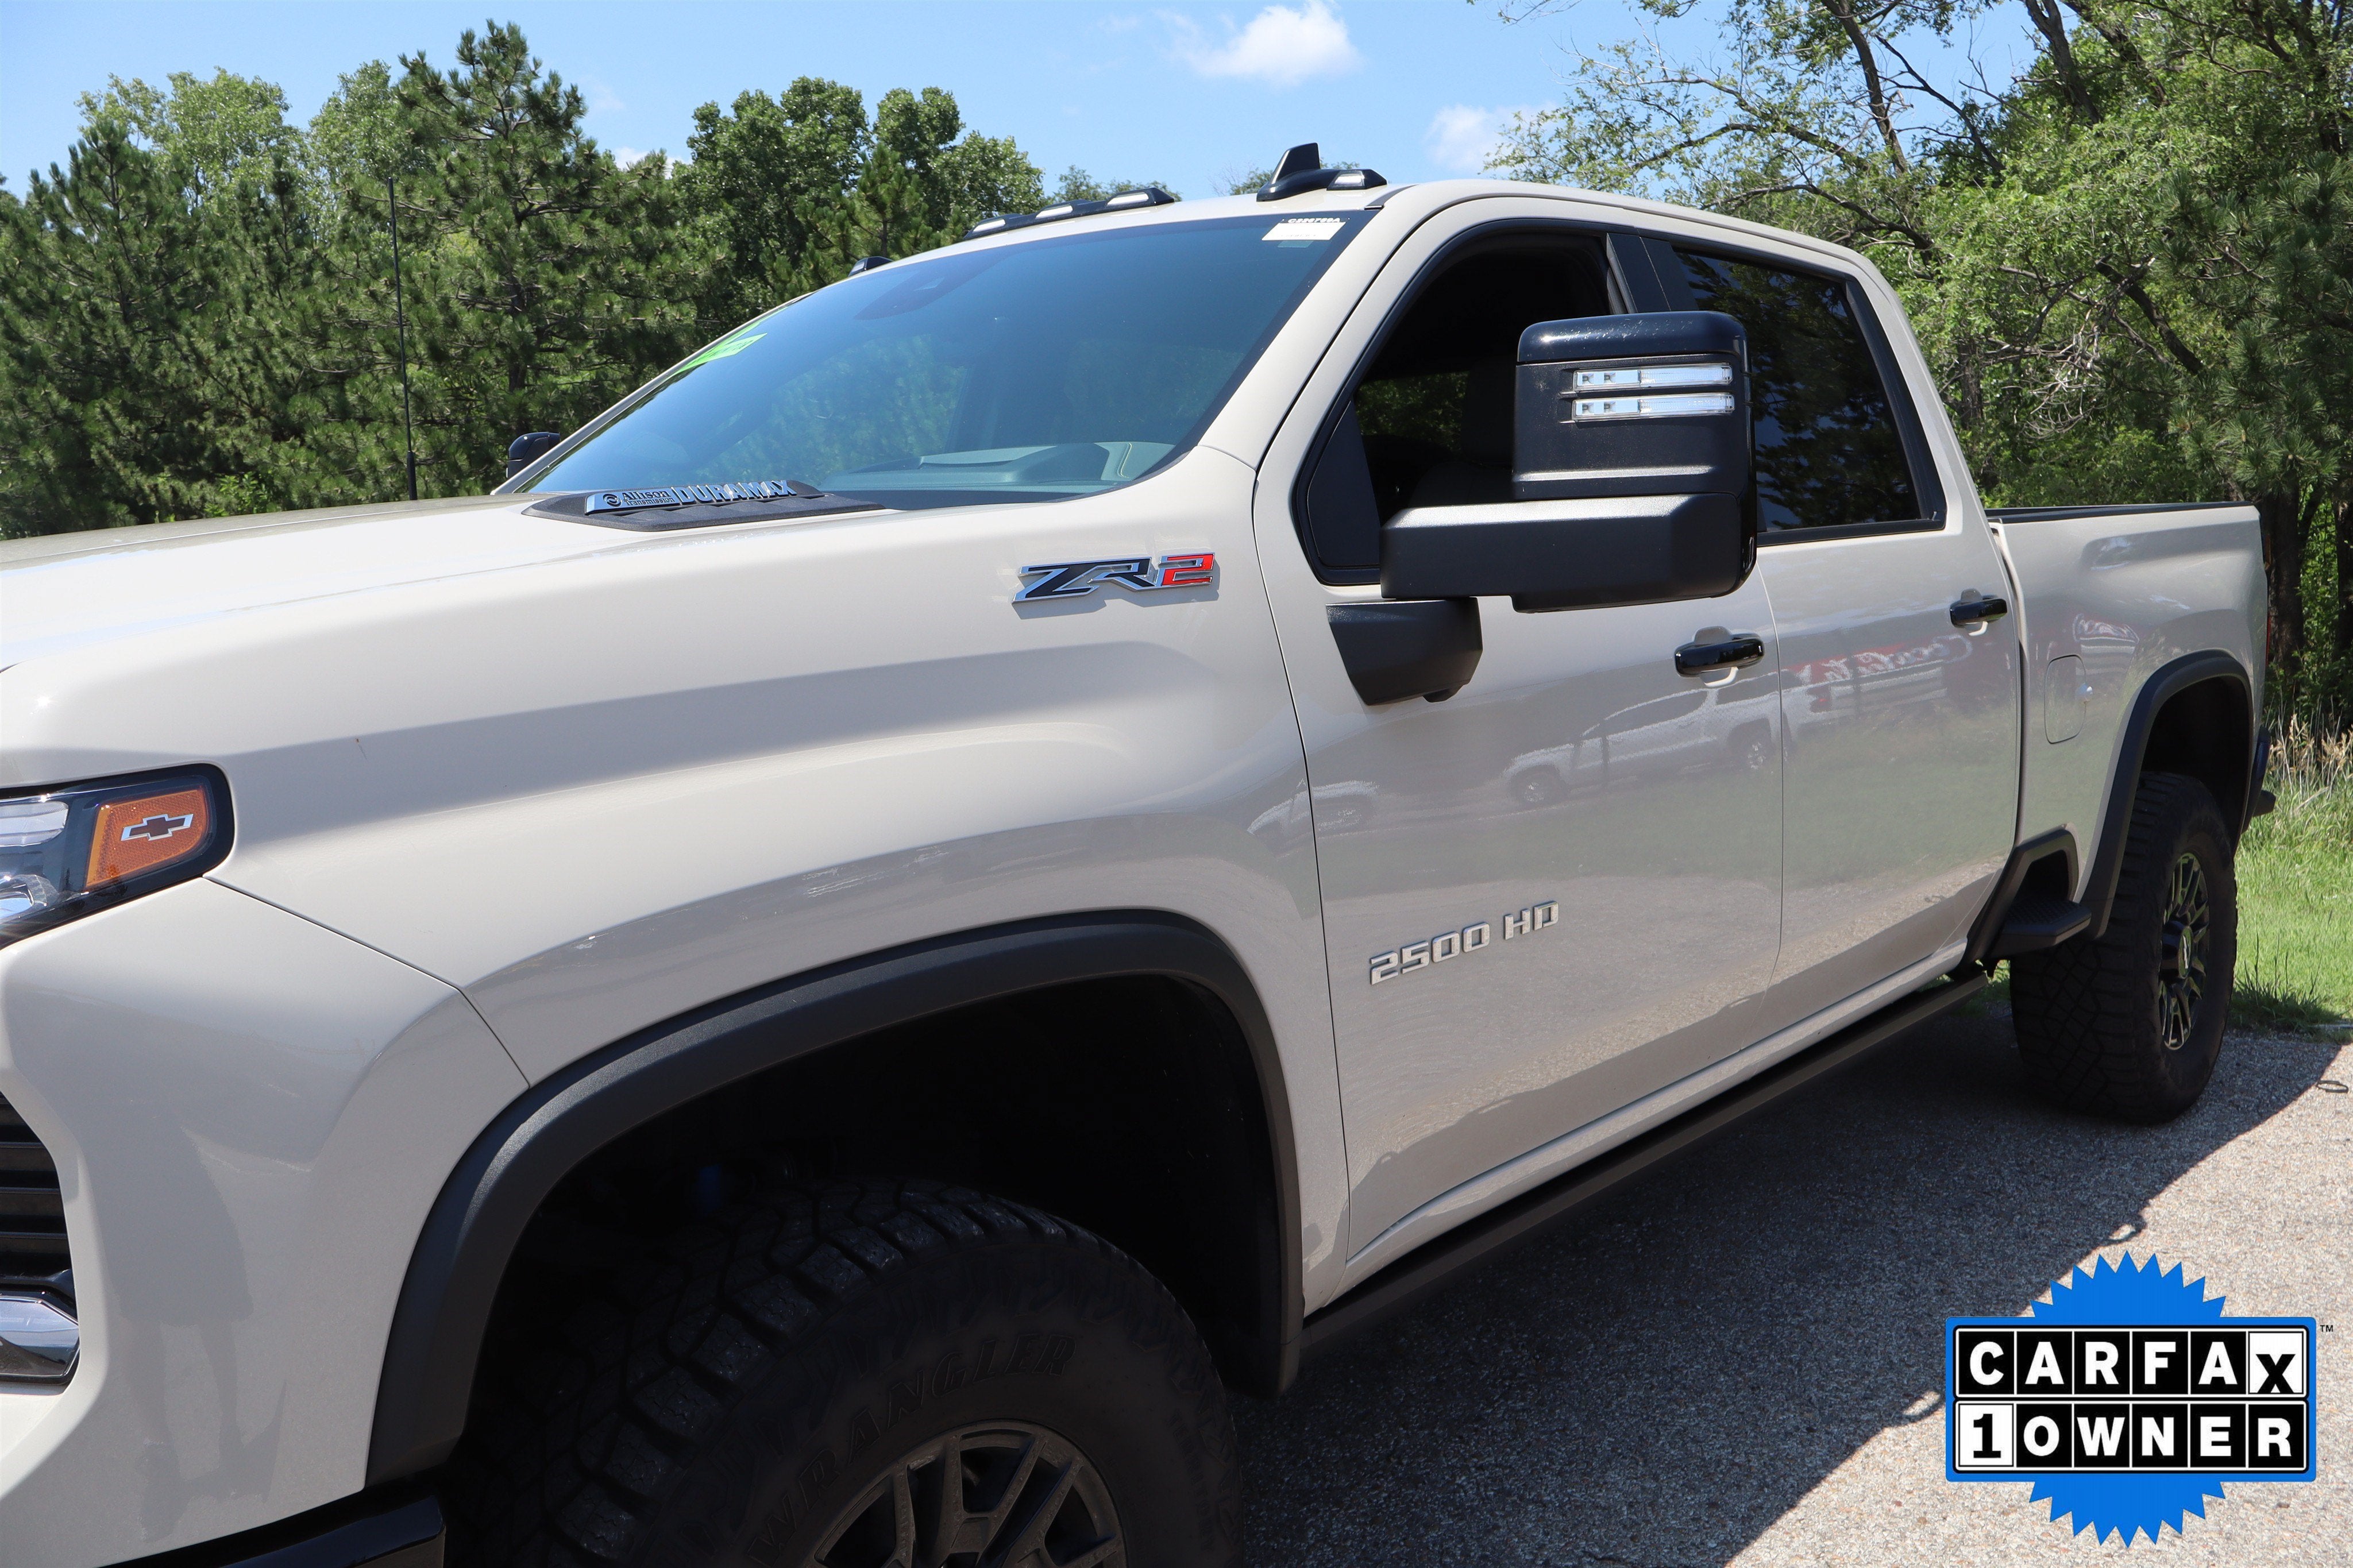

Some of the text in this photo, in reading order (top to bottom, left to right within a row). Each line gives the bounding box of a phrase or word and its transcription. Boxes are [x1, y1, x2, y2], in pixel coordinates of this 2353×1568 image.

[621, 490, 672, 501] Allison
[623, 497, 675, 506] Transmission
[671, 480, 797, 505] DURAMAX
[1011, 552, 1216, 604] ZR2
[1370, 900, 1559, 985] 2500 HD
[746, 1333, 1077, 1568] WRANGLER
